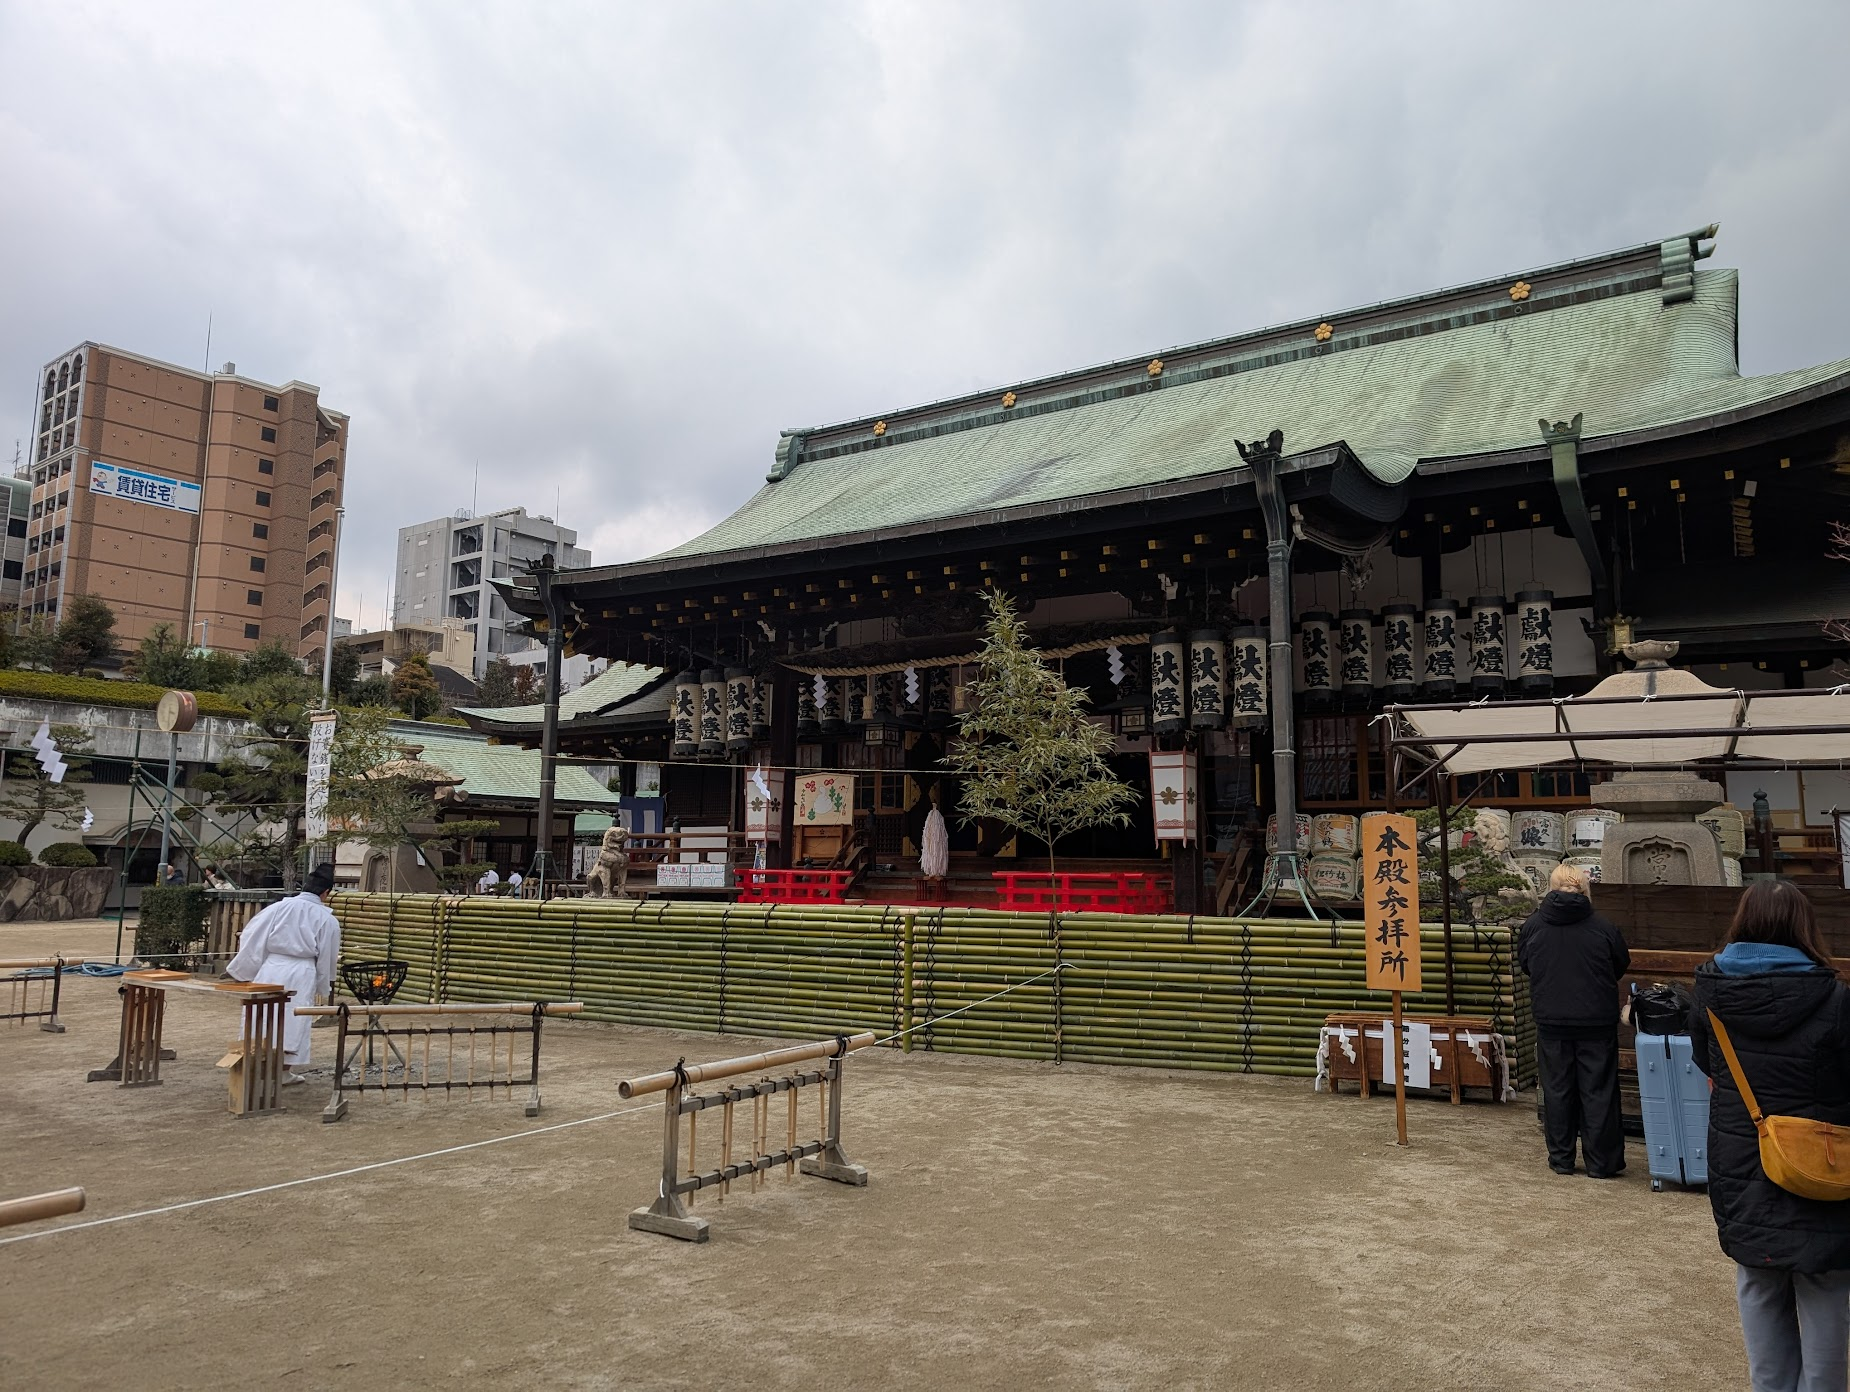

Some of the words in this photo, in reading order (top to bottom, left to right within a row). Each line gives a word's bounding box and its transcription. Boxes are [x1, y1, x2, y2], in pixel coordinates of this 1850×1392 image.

[116, 475, 171, 502] 賃貸住宅
[1646, 848, 1671, 885] 常
[1373, 825, 1411, 984] 本殿参拝所
